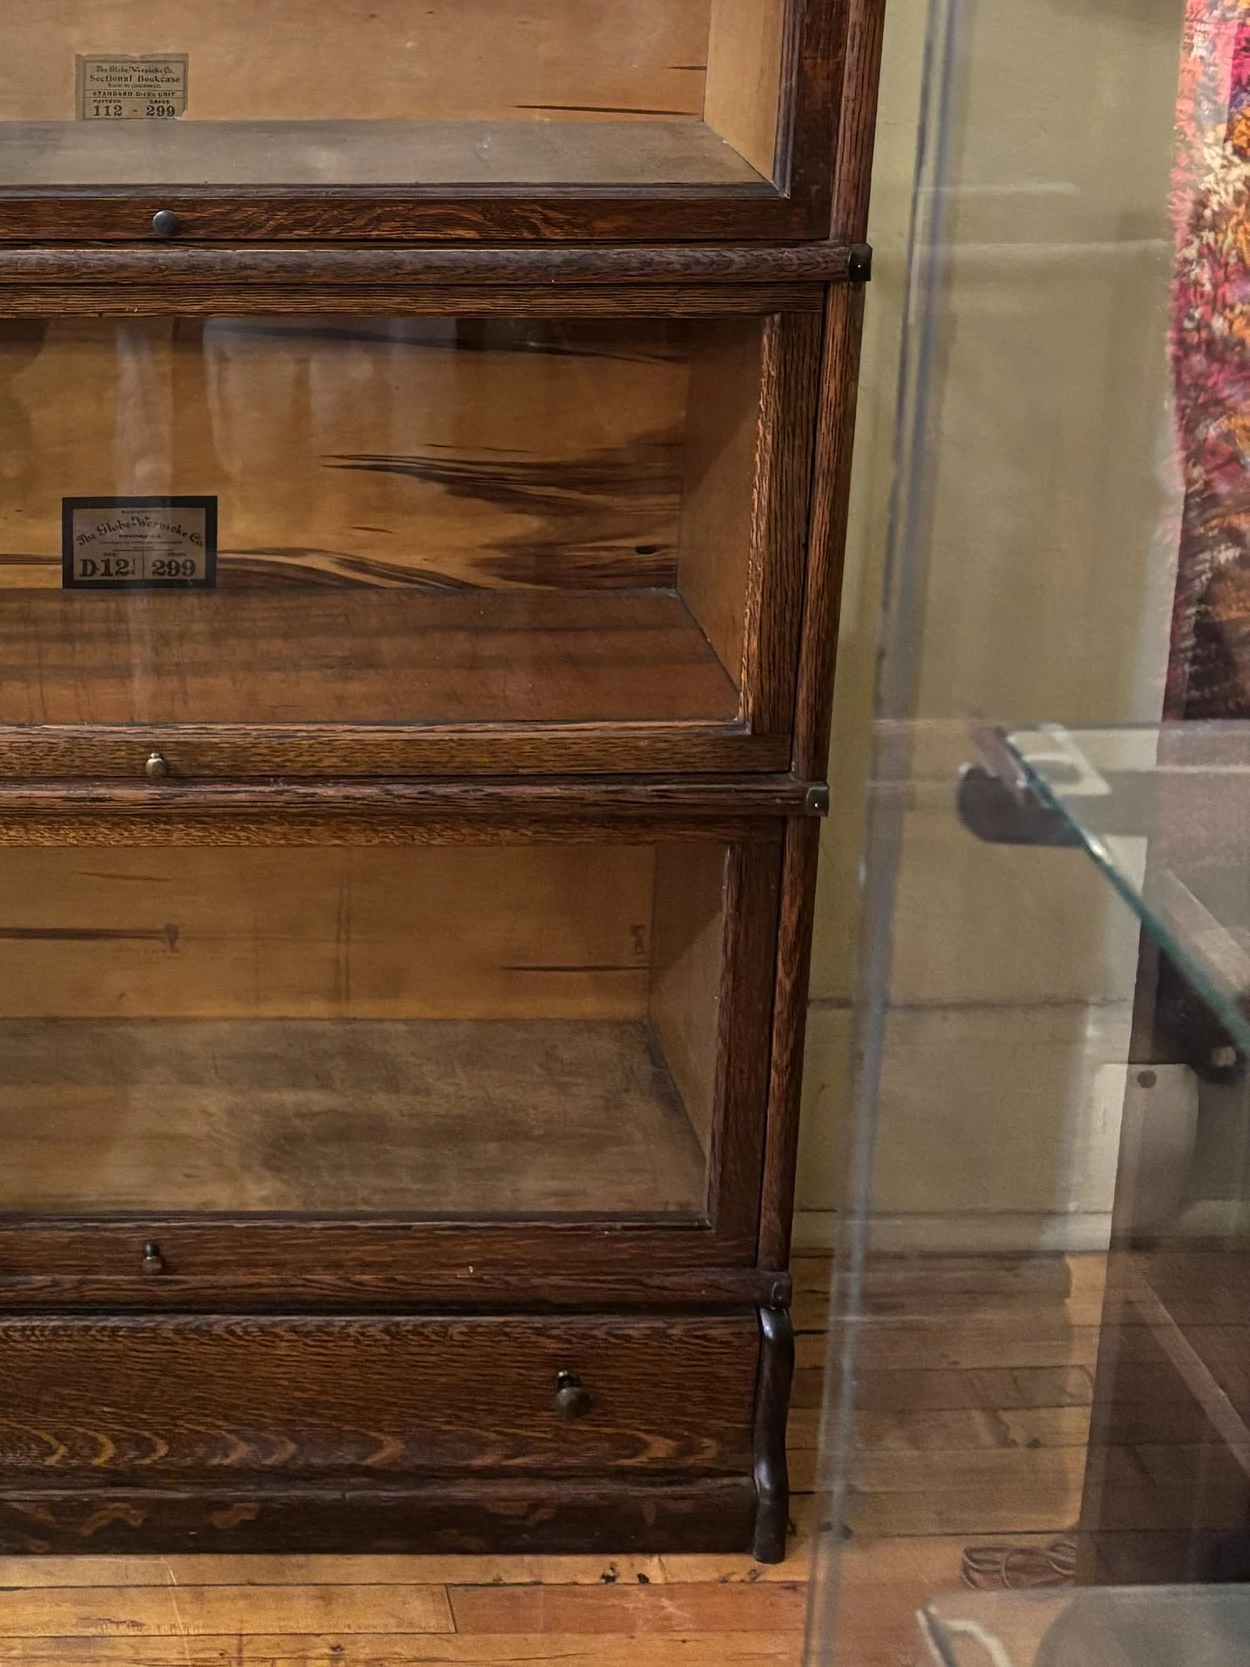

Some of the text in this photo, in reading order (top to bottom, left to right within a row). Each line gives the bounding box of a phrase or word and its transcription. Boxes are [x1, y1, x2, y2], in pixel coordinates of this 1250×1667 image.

[90, 75, 181, 83] Sectional Bookcase
[93, 104, 123, 117] 112
[146, 105, 176, 117] 299
[76, 532, 96, 546] The
[151, 558, 196, 578] 299
